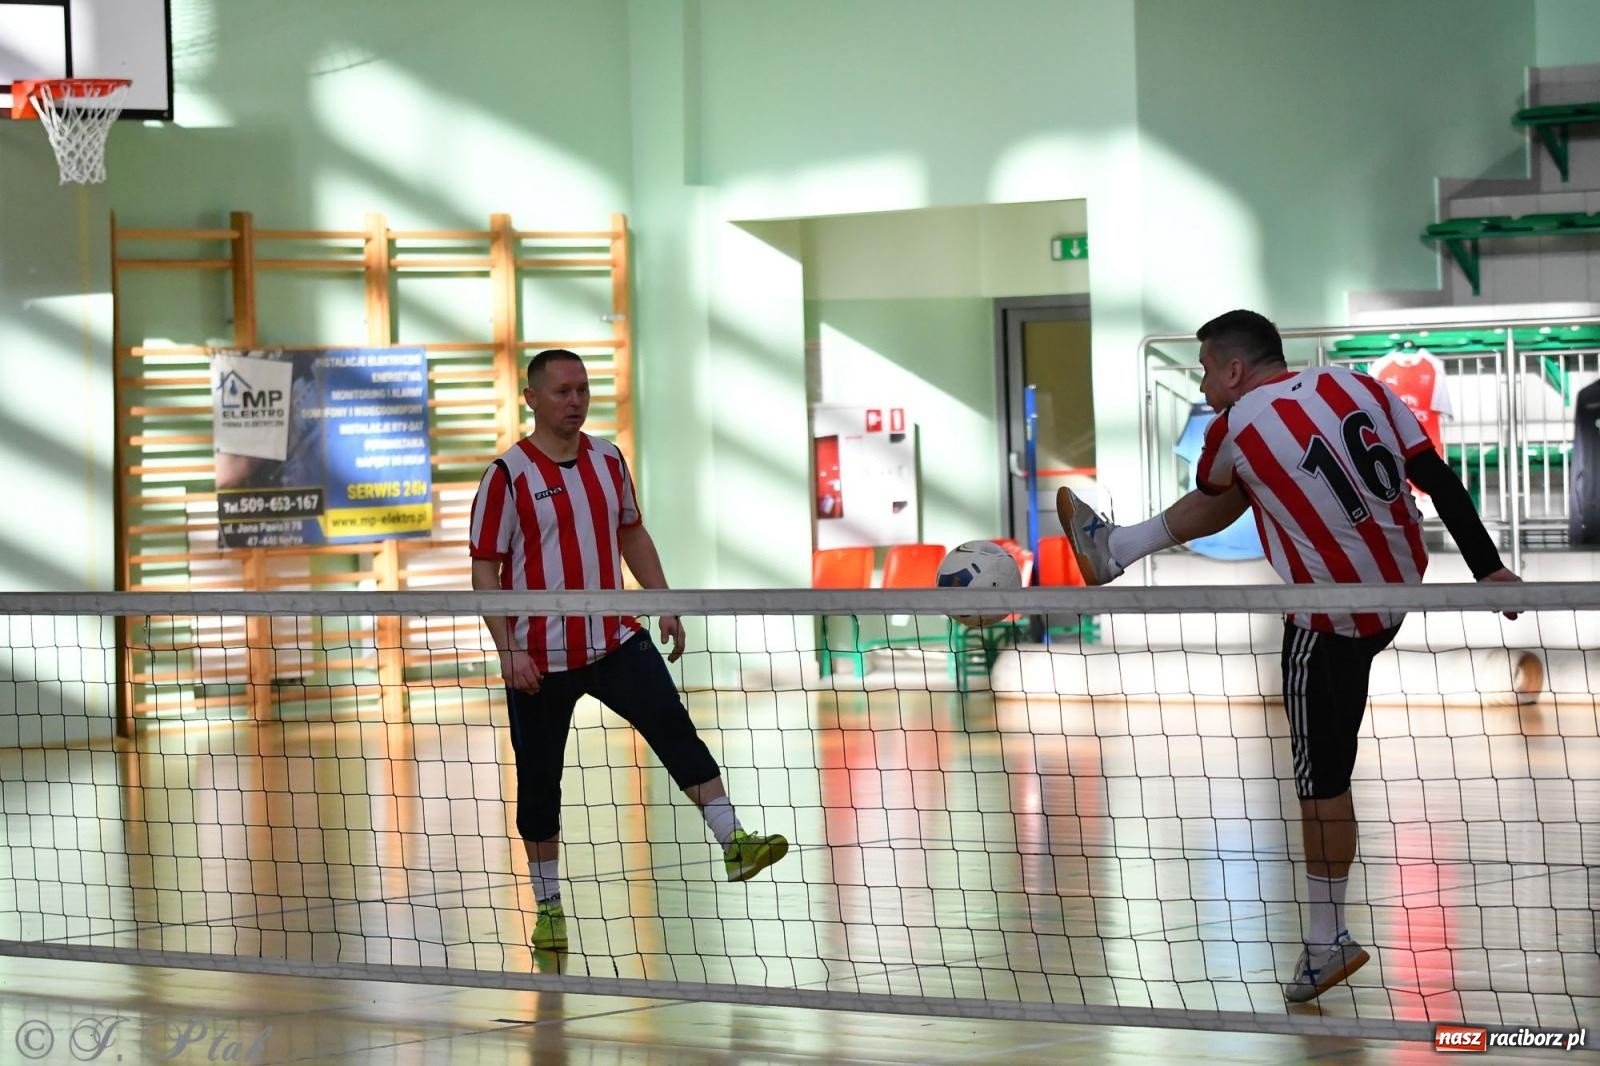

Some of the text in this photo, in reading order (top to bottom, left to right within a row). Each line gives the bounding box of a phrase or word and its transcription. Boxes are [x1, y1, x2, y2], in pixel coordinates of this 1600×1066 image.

[242, 390, 283, 408] MP
[222, 409, 285, 419] ELEKTRO
[1297, 409, 1402, 527] 16
[347, 483, 401, 500] SERWIS
